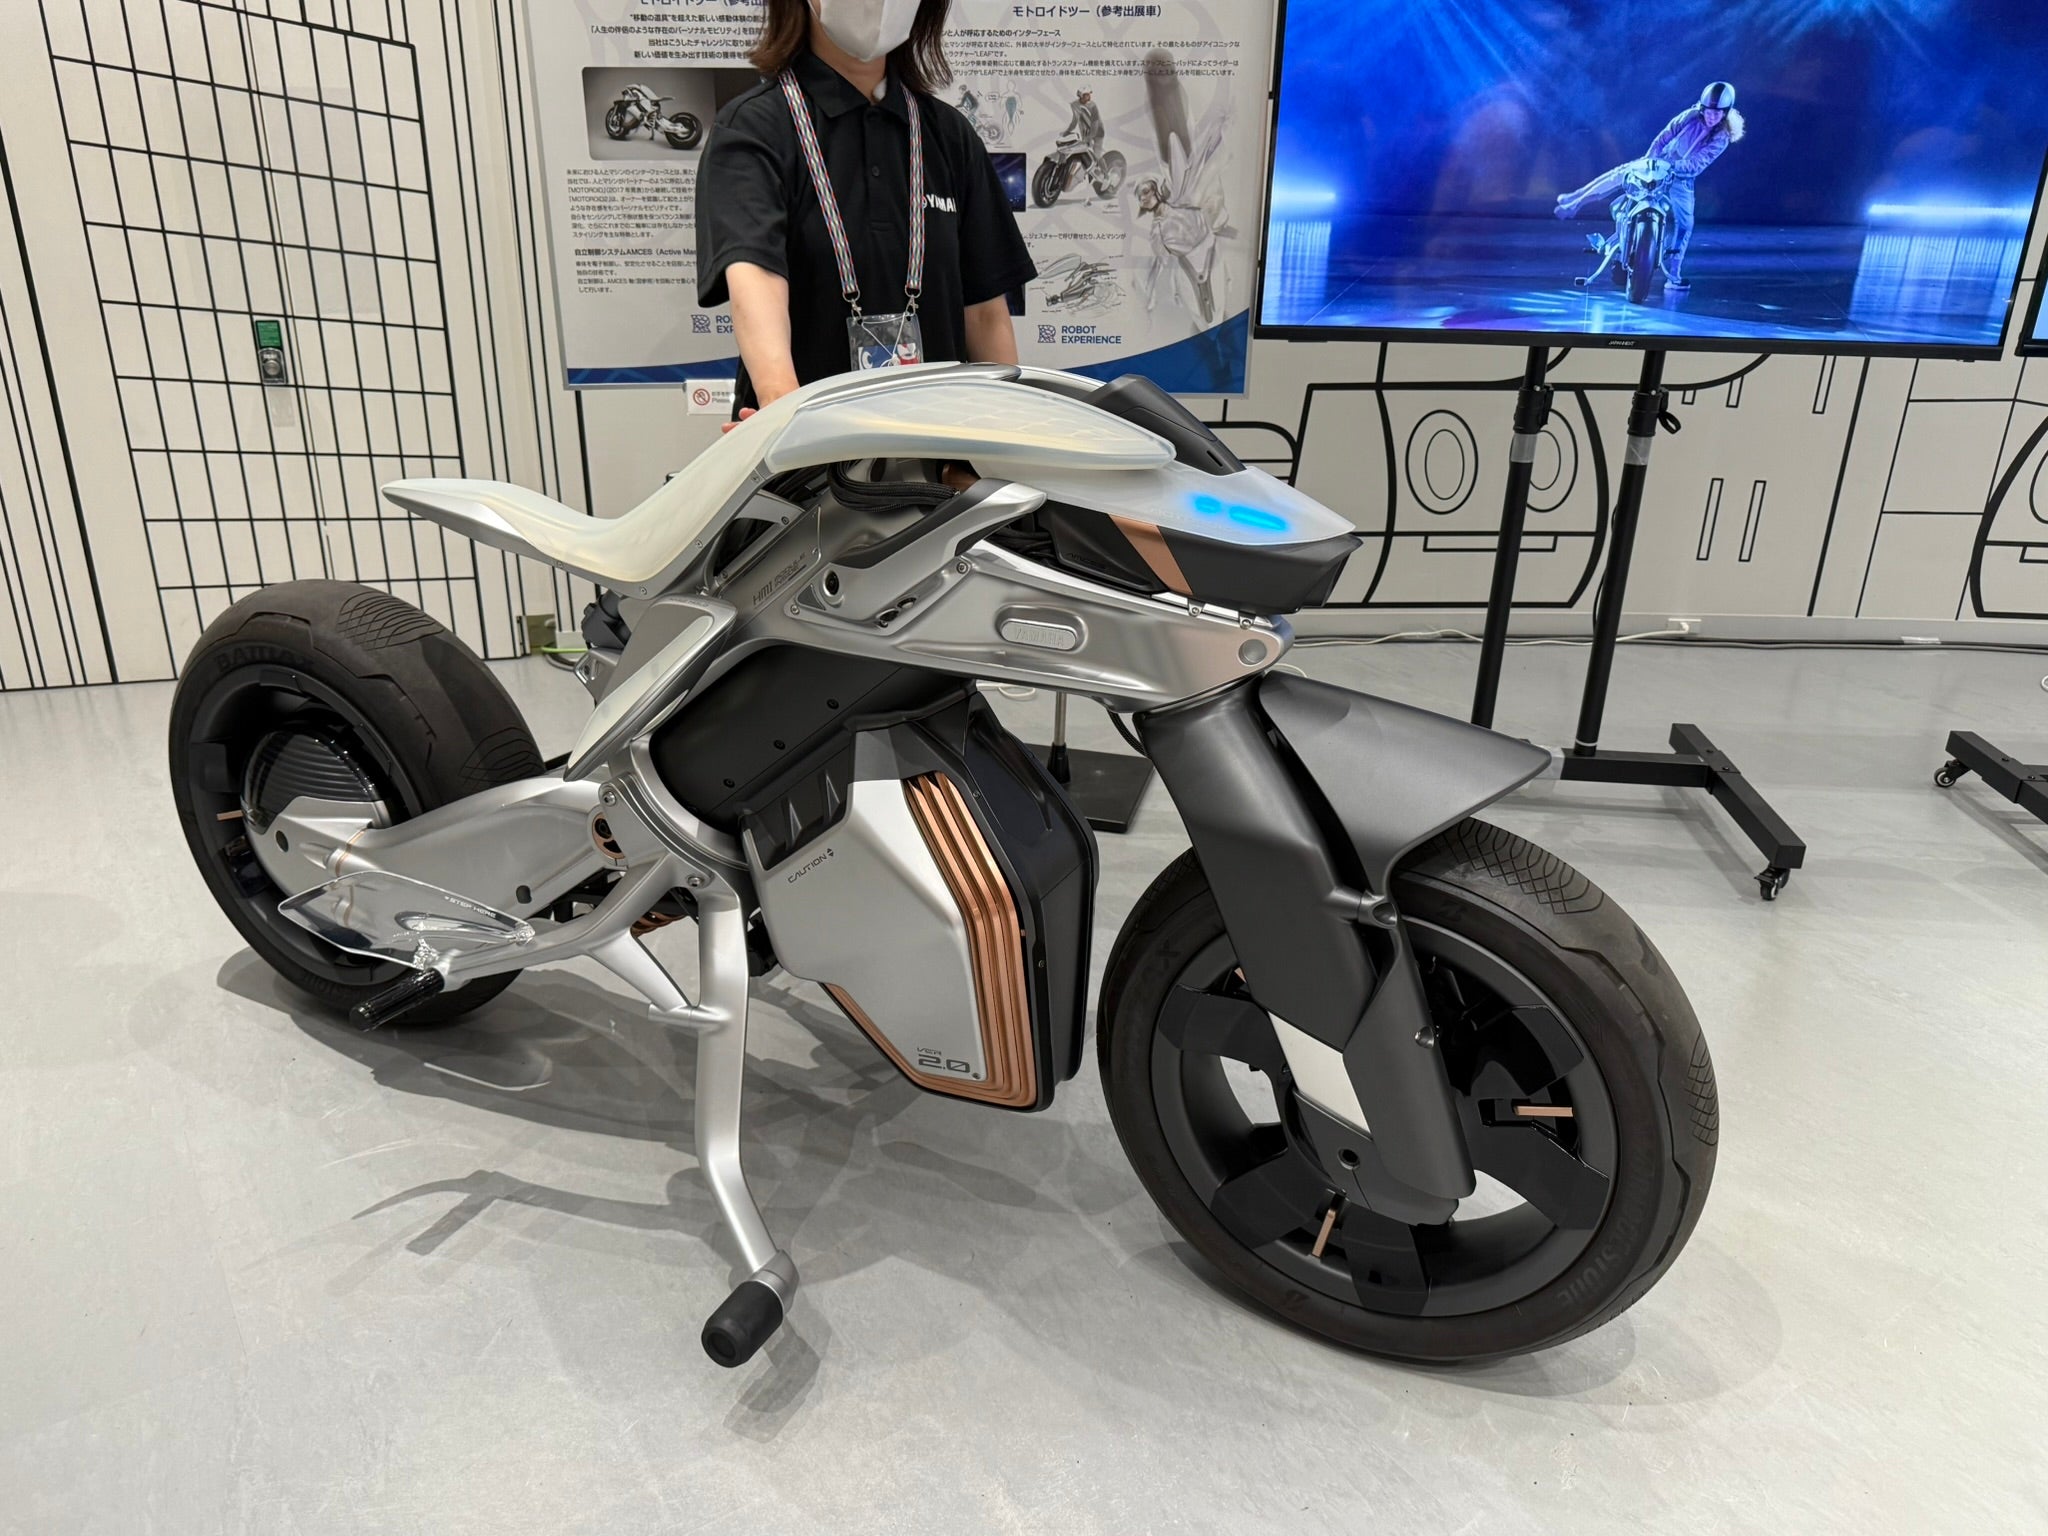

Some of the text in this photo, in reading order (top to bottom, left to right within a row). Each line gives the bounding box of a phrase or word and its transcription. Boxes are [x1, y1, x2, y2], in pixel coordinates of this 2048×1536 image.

[1012, 5, 1162, 18] モトロイドツー（参考出展車）
[1061, 325, 1097, 335] ROBOT
[1061, 335, 1122, 344] EXPERIENCE
[787, 853, 828, 884] CAUTION
[918, 1054, 970, 1074] 2.0
